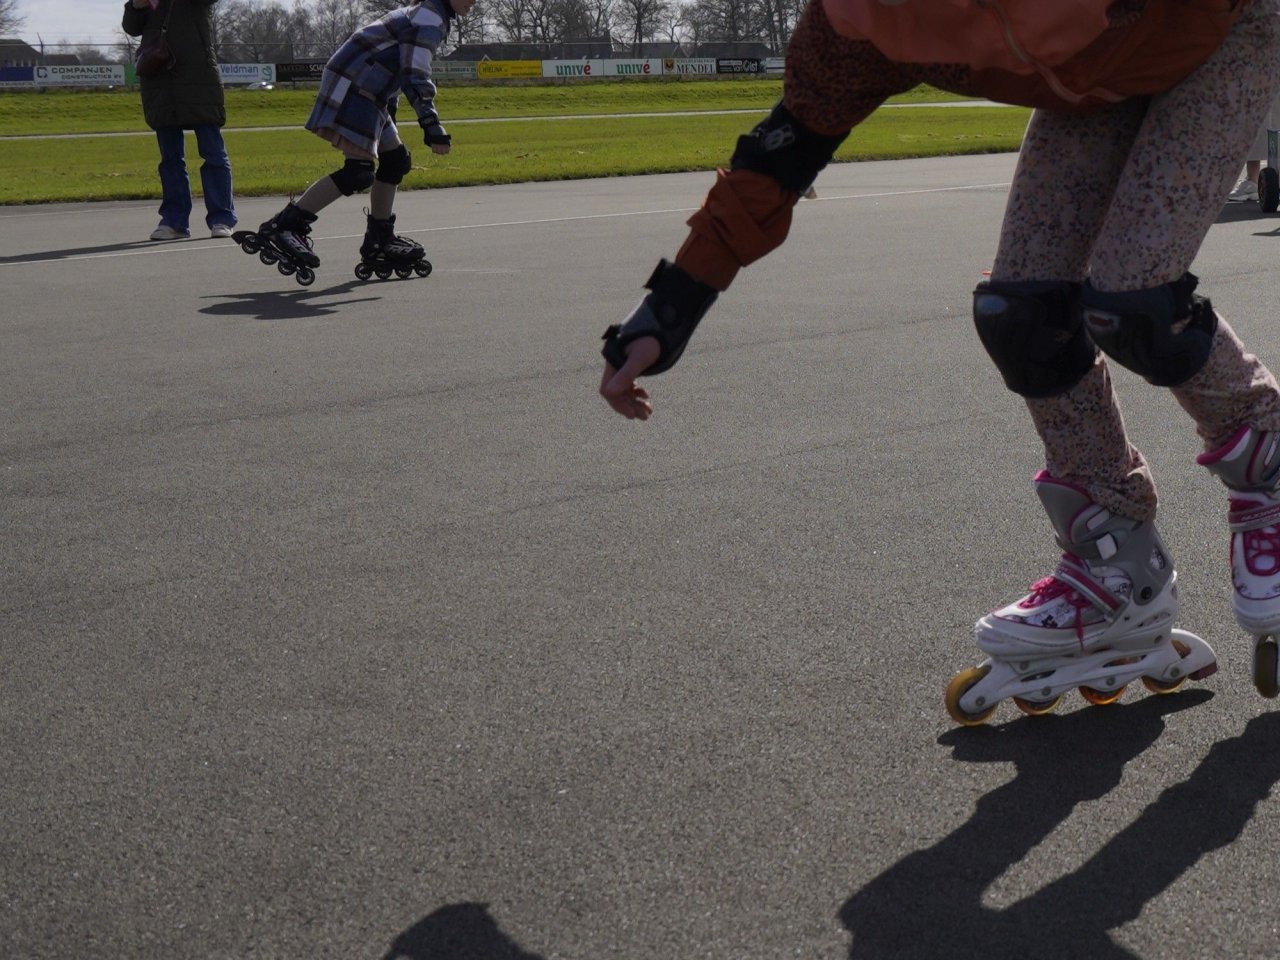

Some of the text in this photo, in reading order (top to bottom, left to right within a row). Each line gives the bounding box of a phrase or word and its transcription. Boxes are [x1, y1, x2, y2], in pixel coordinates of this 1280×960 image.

[51, 66, 112, 74] COMPANJEN
[220, 64, 259, 74] Veldman
[555, 60, 591, 75] univé
[617, 60, 651, 74] univé
[676, 63, 714, 74] MENDEL
